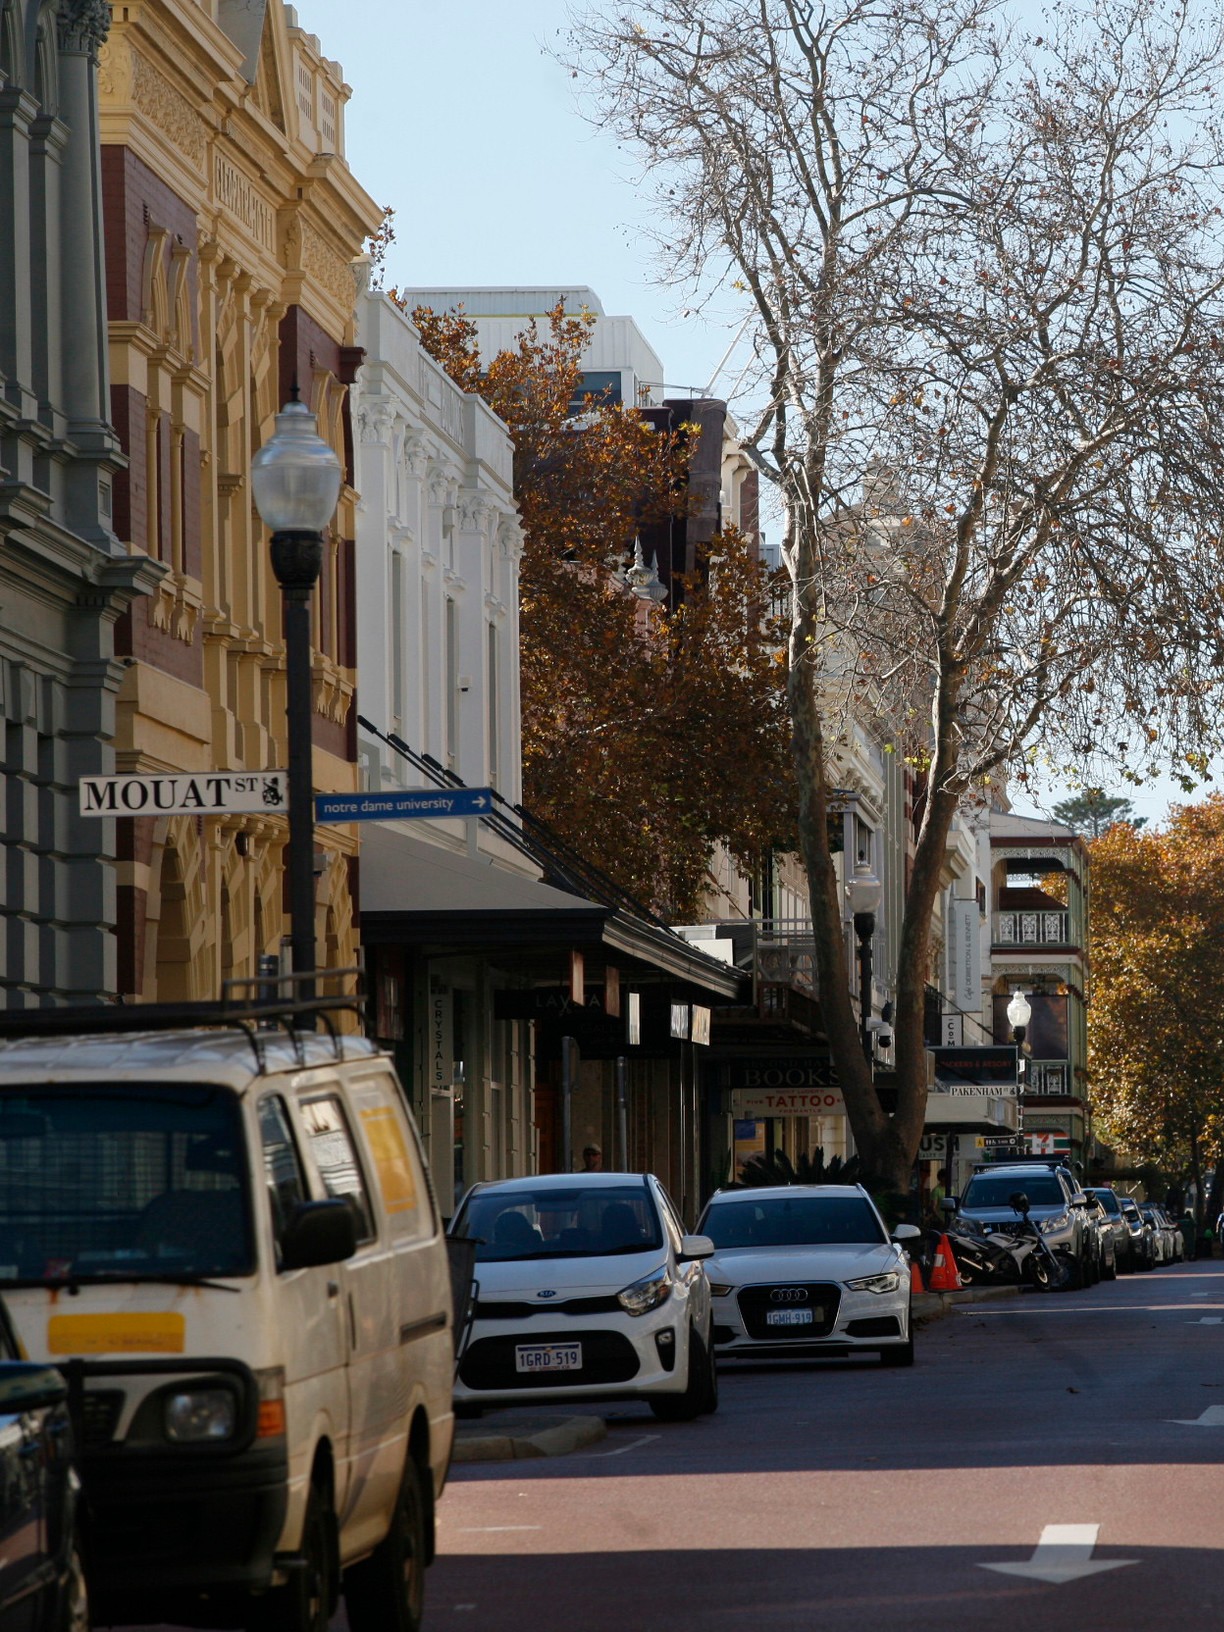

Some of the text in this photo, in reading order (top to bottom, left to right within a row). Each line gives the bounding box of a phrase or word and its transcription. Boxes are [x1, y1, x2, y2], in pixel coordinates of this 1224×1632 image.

[83, 777, 258, 811] MOUAT ST
[324, 797, 454, 813] notre dame university
[434, 999, 443, 1081] CRYSTALS
[743, 1068, 841, 1087] BOOKS
[951, 1087, 1003, 1096] PAKENHAM
[765, 1095, 835, 1108] TATTOO
